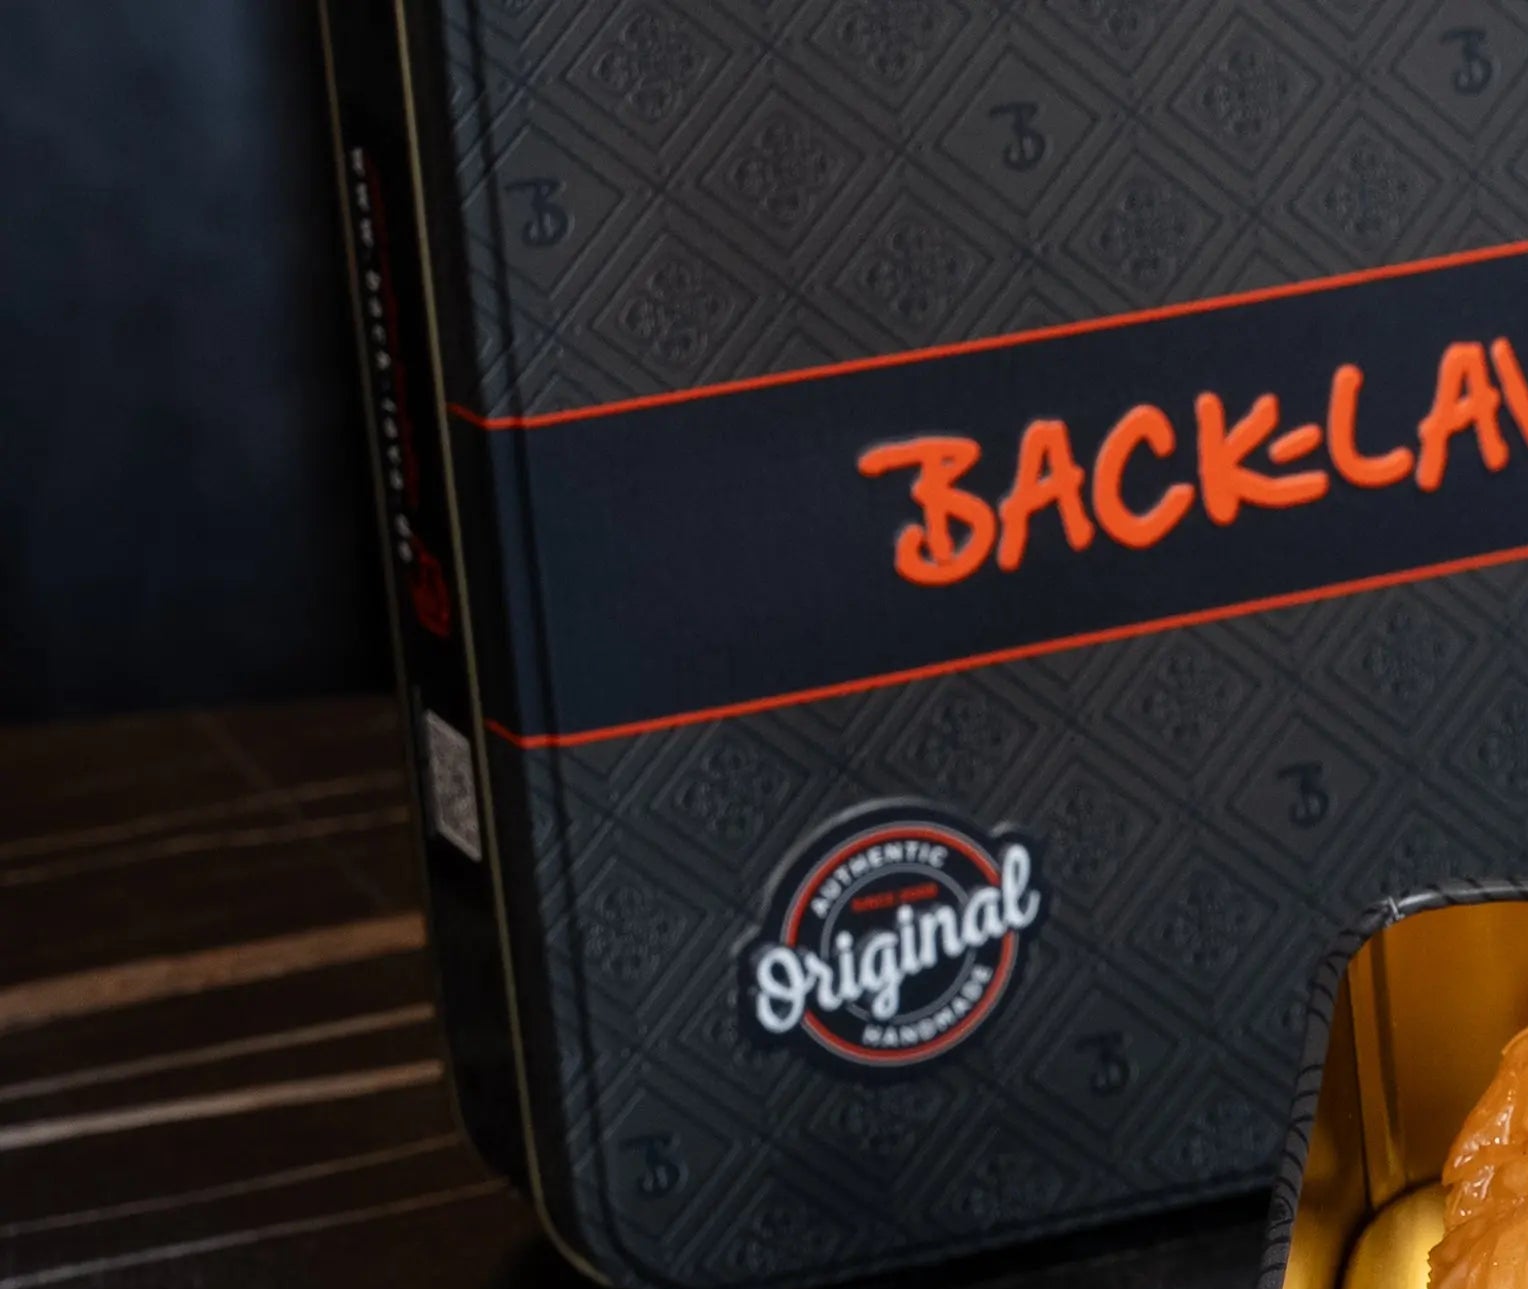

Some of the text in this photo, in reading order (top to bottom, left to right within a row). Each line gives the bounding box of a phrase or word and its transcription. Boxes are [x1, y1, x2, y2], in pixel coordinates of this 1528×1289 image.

[811, 841, 948, 919] AUTHENTIC
[756, 843, 1041, 1034] Original
[862, 964, 994, 1048] HANDMADE
